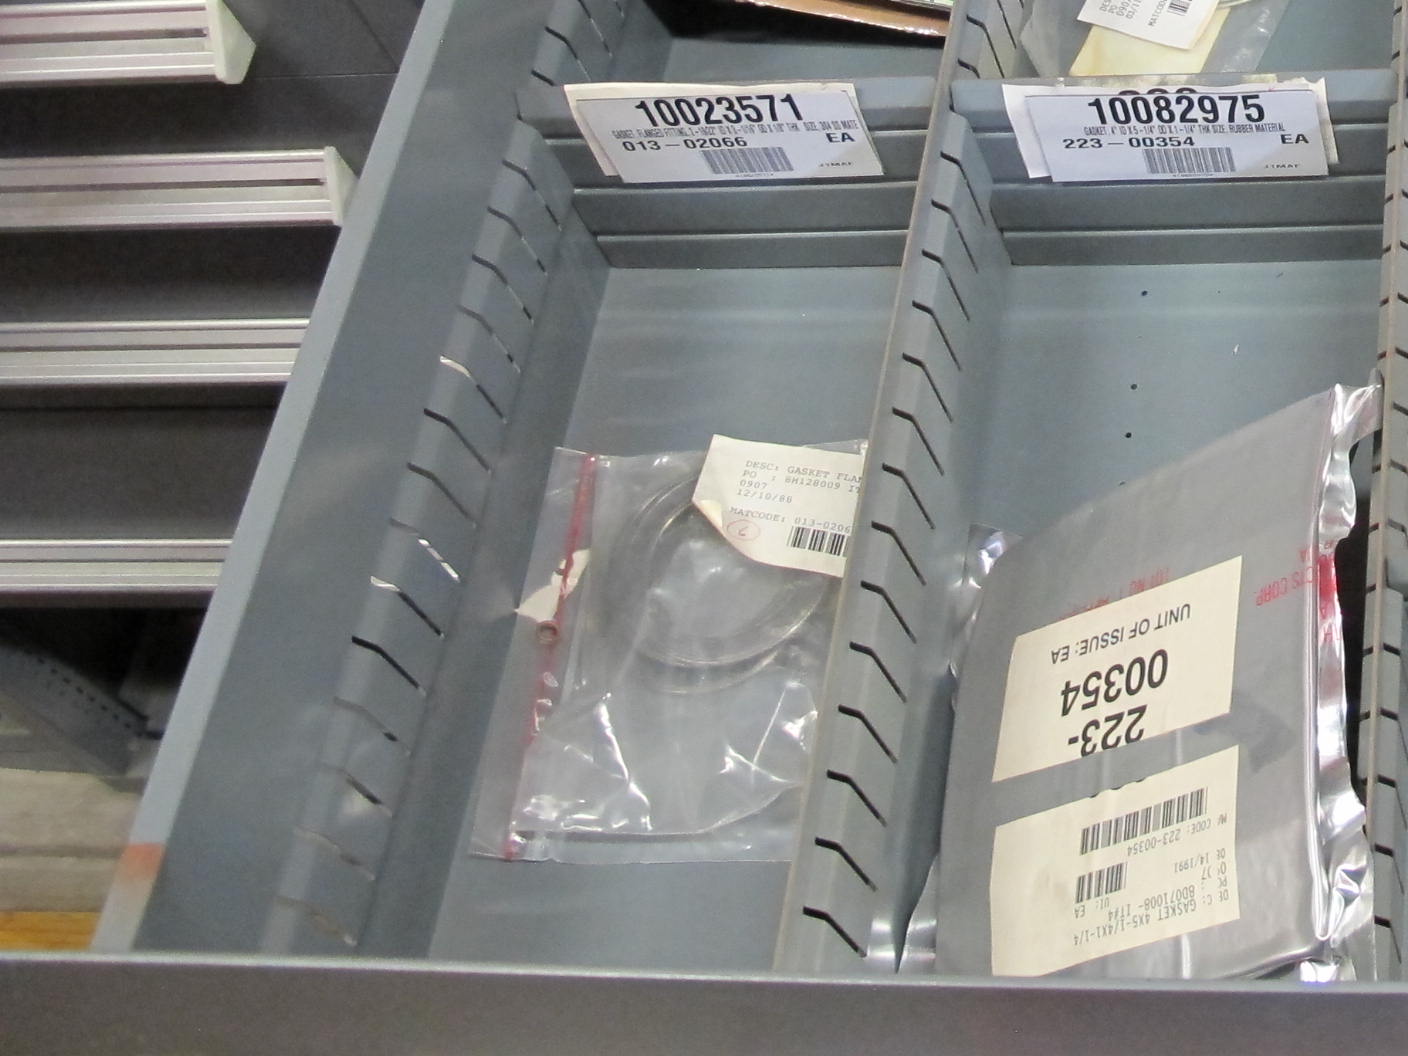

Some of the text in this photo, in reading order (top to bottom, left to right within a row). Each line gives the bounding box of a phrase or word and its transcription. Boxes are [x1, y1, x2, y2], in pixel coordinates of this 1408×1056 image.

[635, 93, 803, 127] 10023571
[1088, 94, 1266, 126] 10082975
[826, 133, 855, 143] EA
[1280, 134, 1309, 144] EA
[787, 465, 830, 479] GASKET
[1050, 603, 1192, 665] UNIT OF ISSUE: EA
[1060, 648, 1170, 717] 00354
[1067, 704, 1149, 758] 223-
[1155, 896, 1197, 923] GASKET
